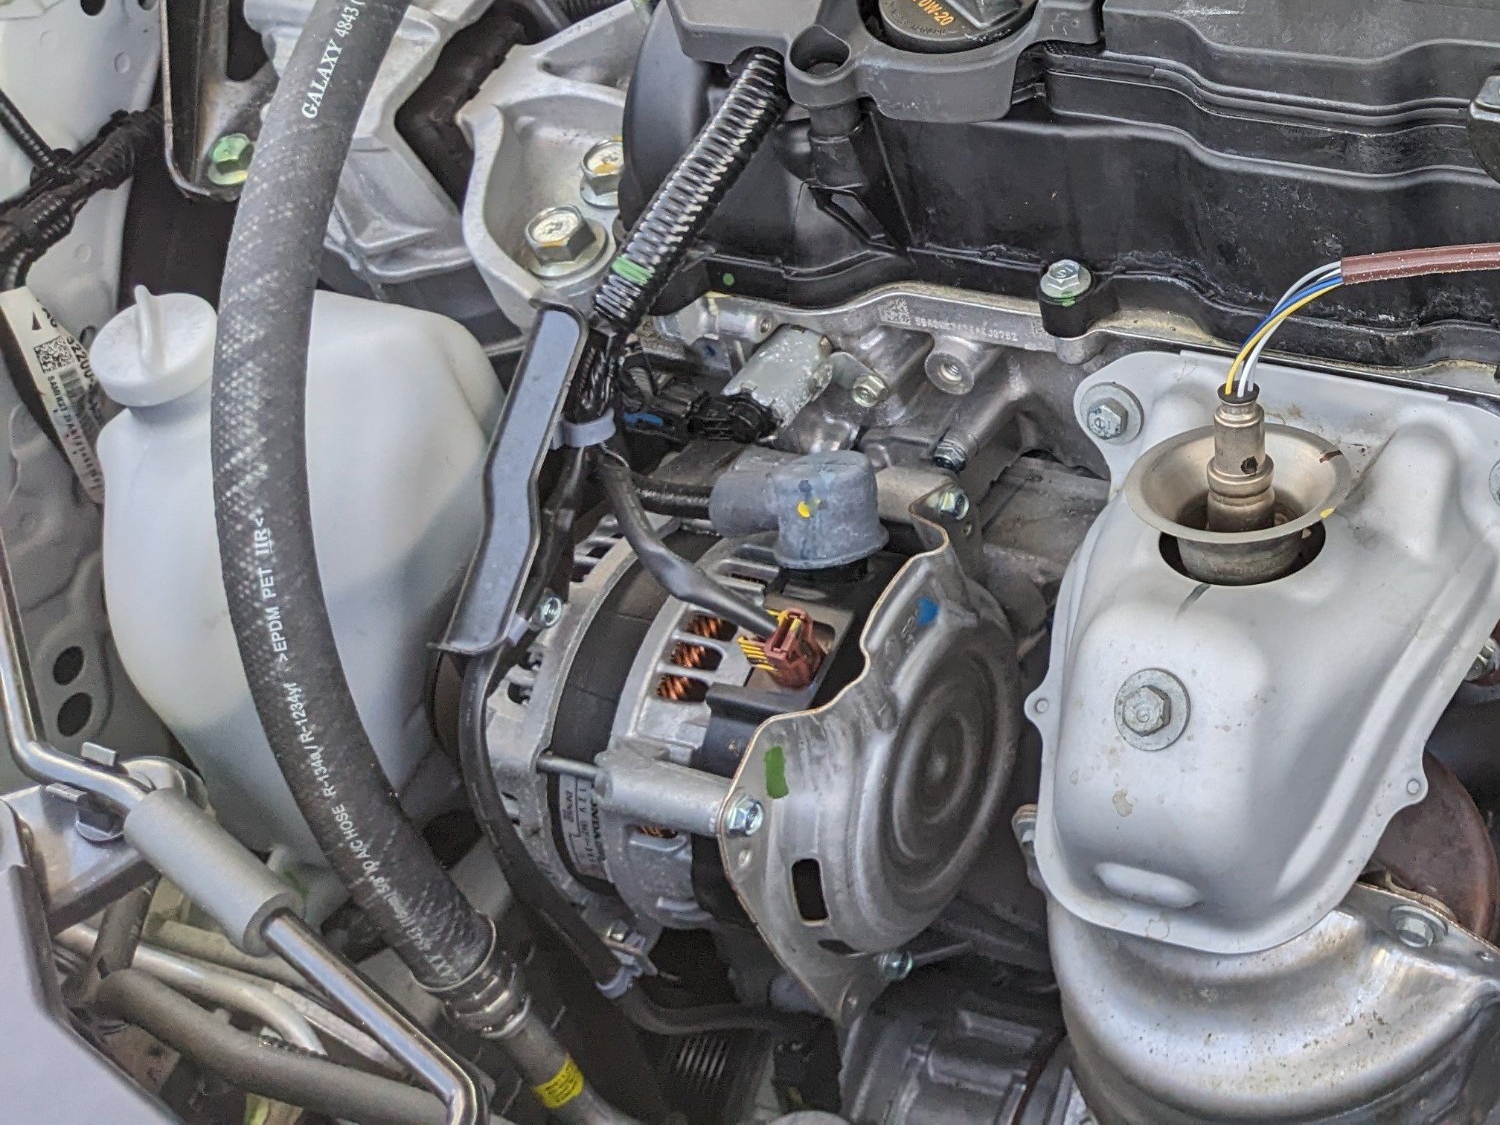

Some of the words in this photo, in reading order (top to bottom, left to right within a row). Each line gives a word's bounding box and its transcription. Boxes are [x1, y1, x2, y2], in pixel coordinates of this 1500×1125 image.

[302, 40, 343, 119] GALAXY
[334, 4, 360, 38] 4843
[258, 568, 276, 599] PET
[332, 804, 357, 839] HOSE
